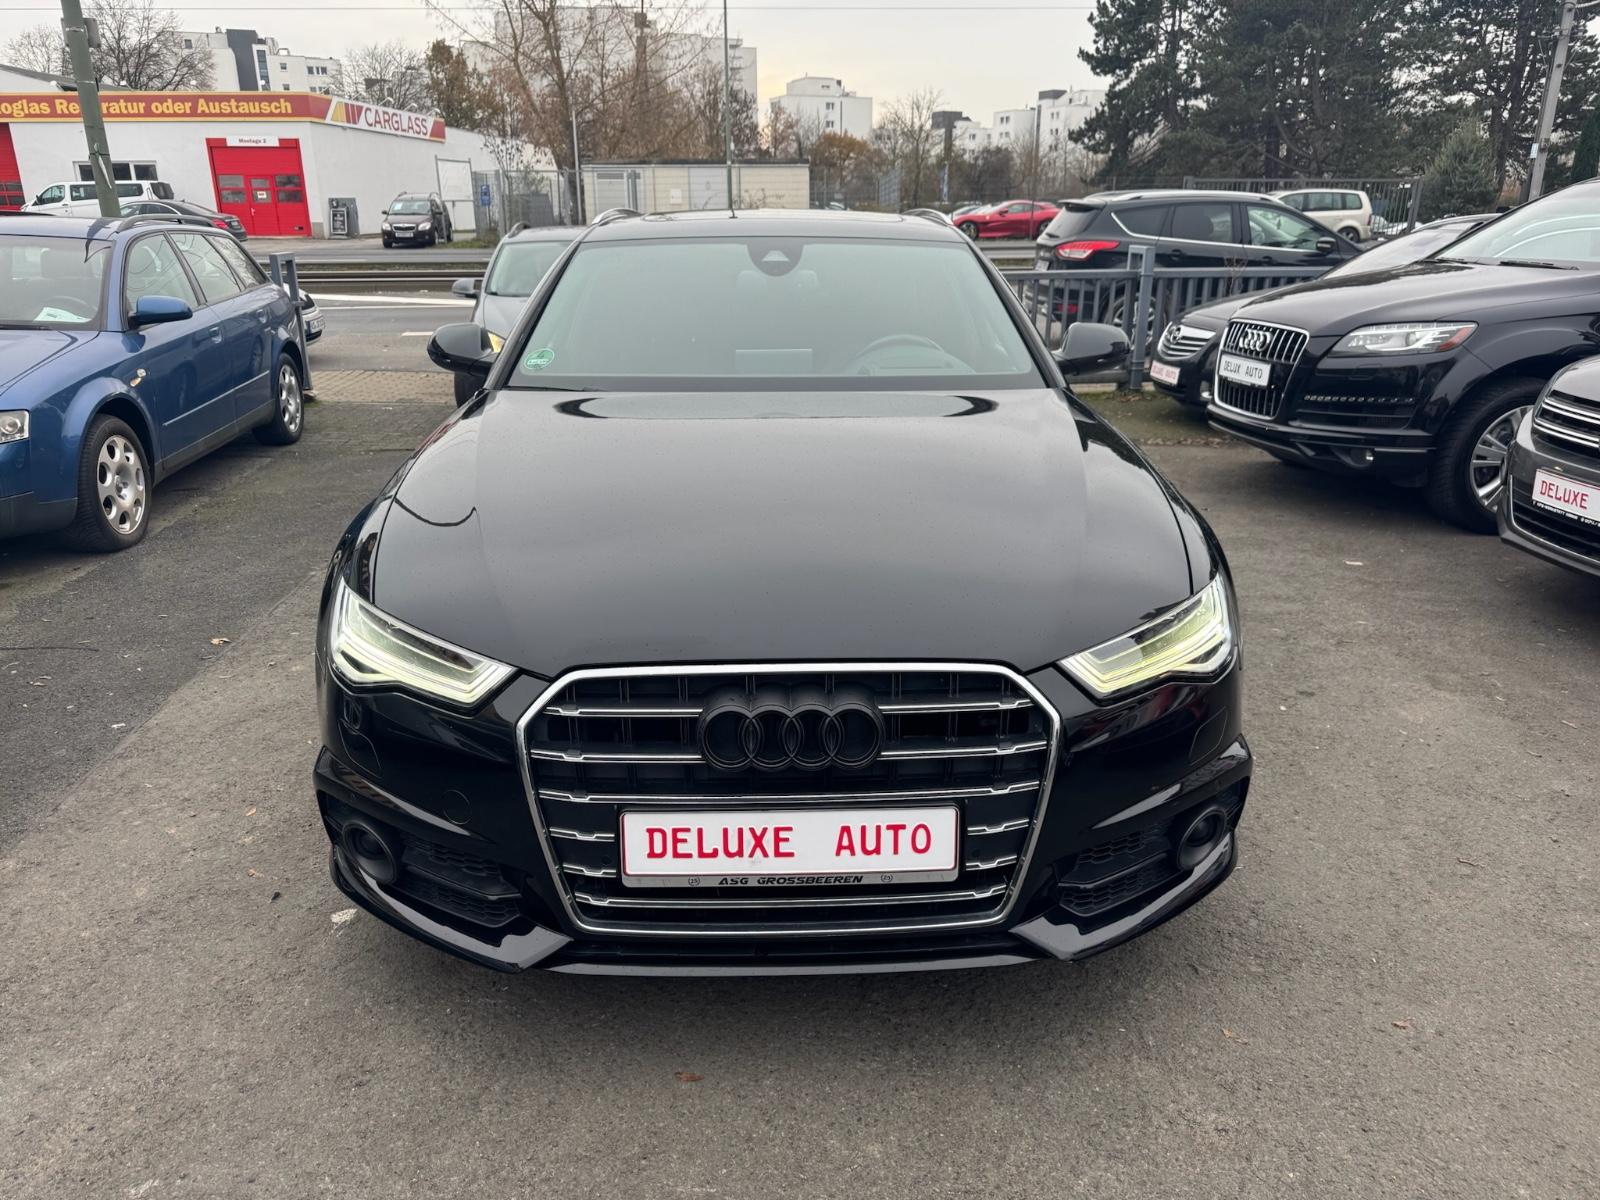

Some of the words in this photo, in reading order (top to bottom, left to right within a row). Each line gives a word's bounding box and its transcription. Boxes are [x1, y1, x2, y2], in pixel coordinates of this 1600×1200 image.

[0, 99, 50, 117] oglas
[55, 99, 145, 114] Reratur
[151, 99, 192, 114] oder
[197, 98, 292, 114] Austausch
[364, 107, 428, 136] CARGLASS
[1245, 365, 1263, 379] AUTO
[1540, 480, 1589, 510] DELUXE
[646, 826, 795, 859] DELUXE
[835, 823, 932, 856] AUTO
[718, 877, 749, 885] ASG
[757, 875, 863, 885] GROSSBEEREN
